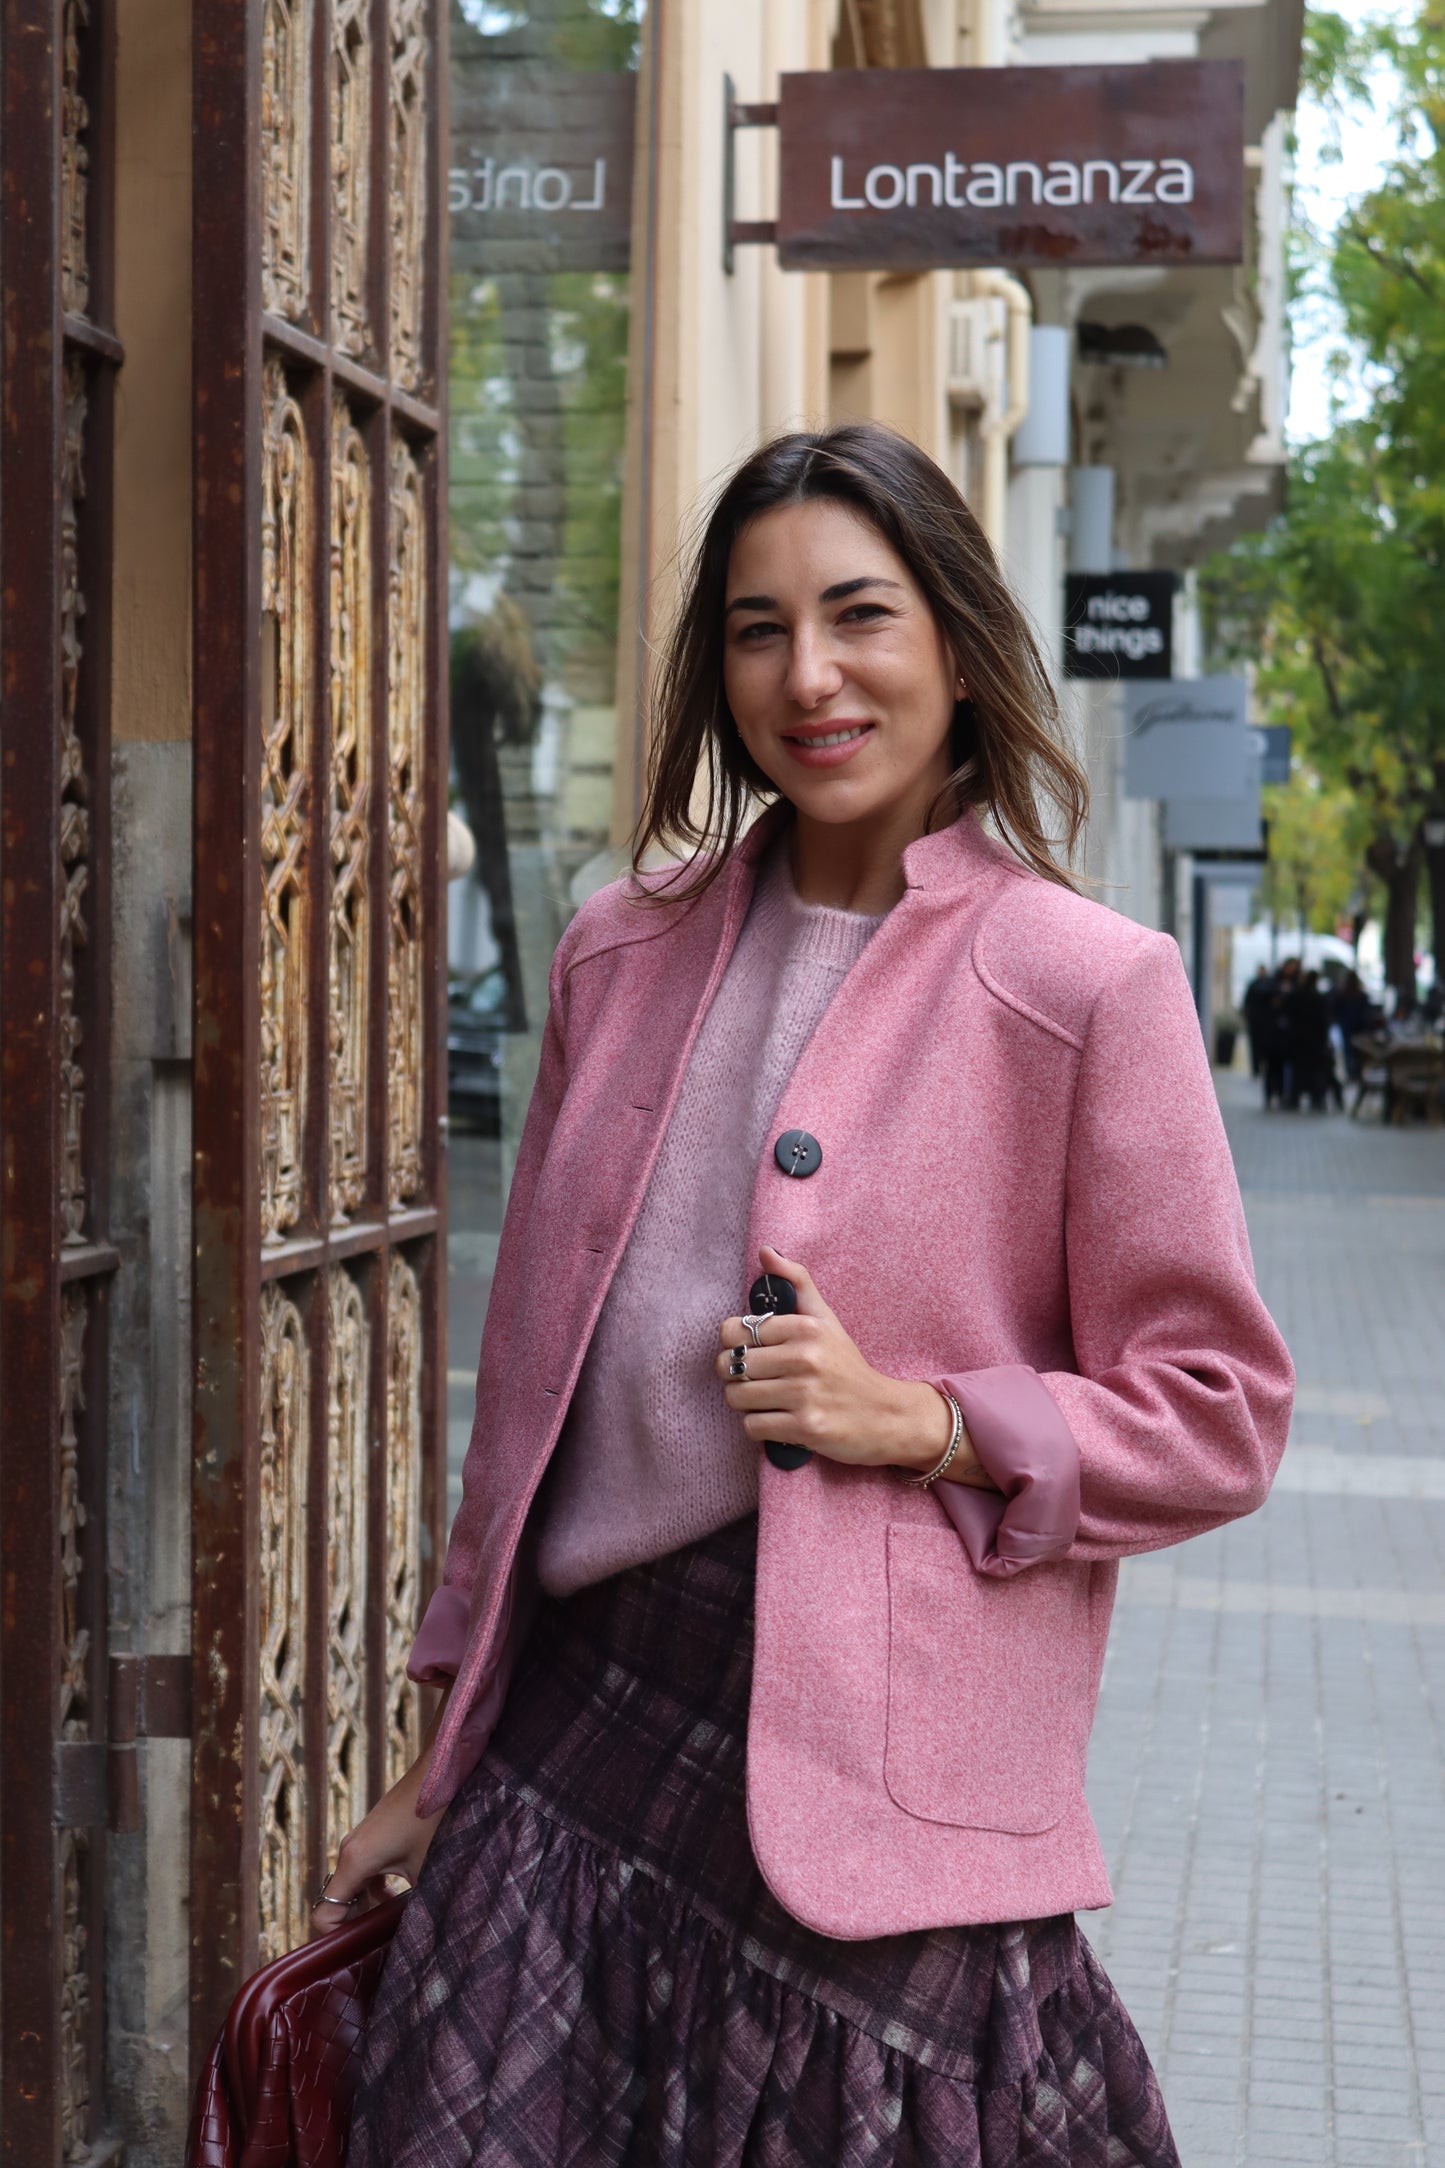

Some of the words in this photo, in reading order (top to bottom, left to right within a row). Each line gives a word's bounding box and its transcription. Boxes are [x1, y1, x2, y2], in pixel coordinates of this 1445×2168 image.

[831, 152, 1194, 209] Lontananza
[1087, 591, 1149, 622] nice
[1074, 625, 1164, 660] things
